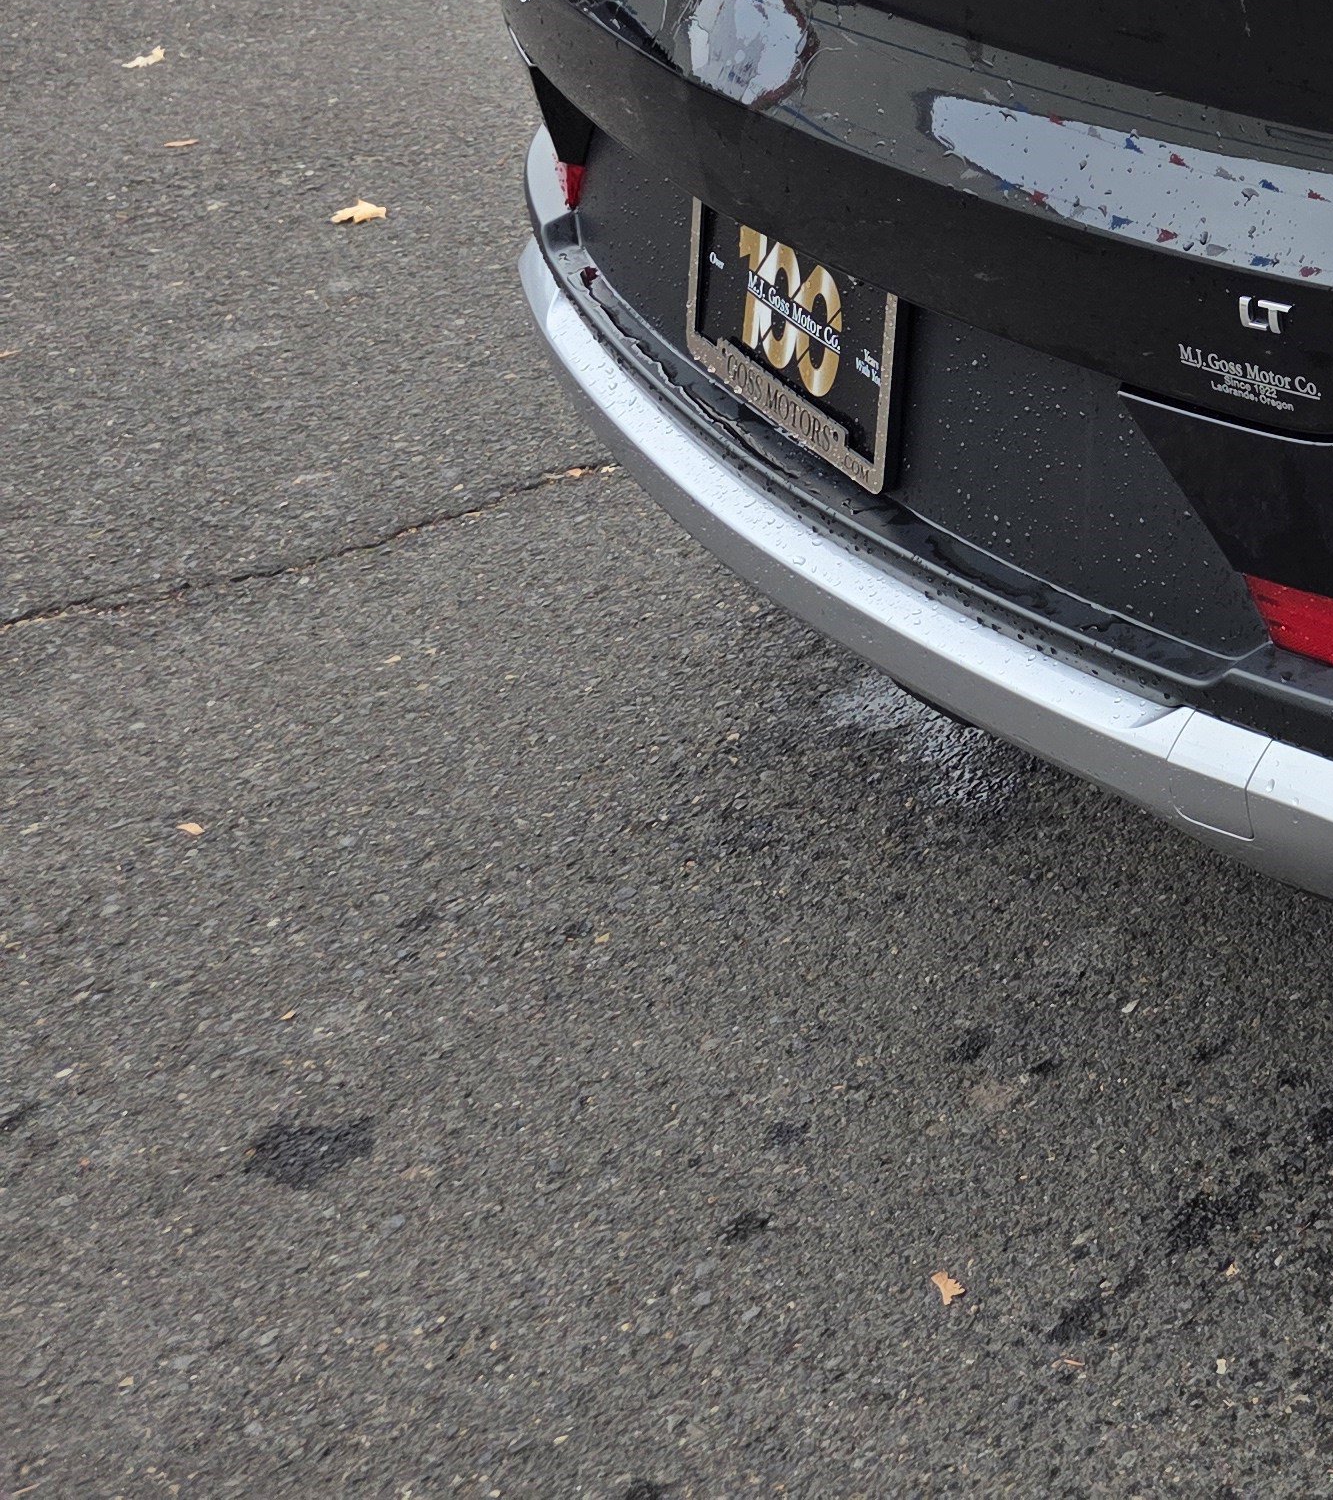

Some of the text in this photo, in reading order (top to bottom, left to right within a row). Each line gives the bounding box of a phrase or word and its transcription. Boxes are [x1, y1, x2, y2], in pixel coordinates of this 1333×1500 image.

[709, 251, 725, 270] Over
[739, 224, 842, 398] 100
[748, 270, 842, 350] M.J. Goss Motor Co.
[1239, 296, 1293, 334] LT
[855, 356, 871, 378] With
[863, 348, 880, 371] Years
[1178, 343, 1322, 396] M.J. Goss Motor Co.
[1223, 375, 1278, 399] Since 1922
[1259, 394, 1295, 411] Oregon
[727, 354, 833, 452] GOSS MOTORS
